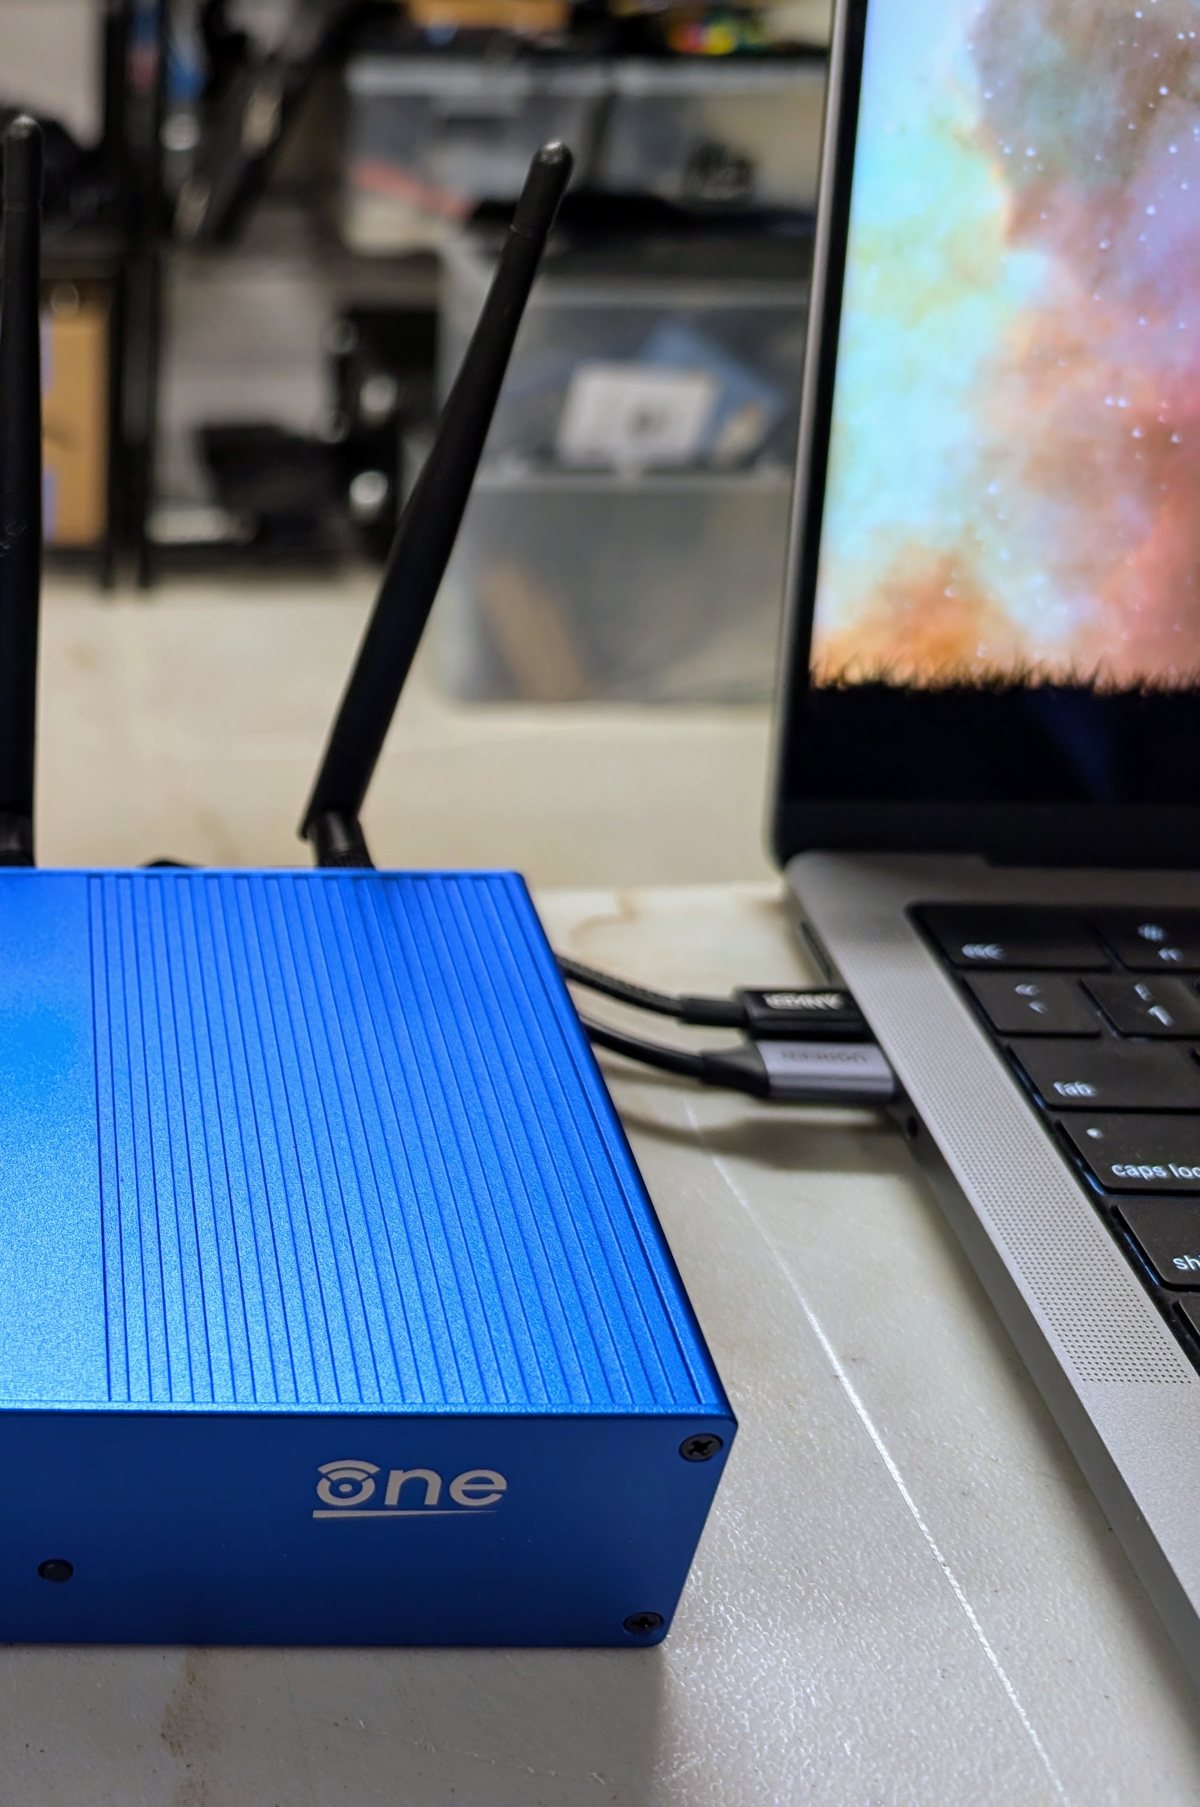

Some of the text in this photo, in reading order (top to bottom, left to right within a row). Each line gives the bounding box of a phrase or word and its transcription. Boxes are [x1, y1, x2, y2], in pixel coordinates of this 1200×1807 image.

[1053, 1082, 1097, 1097] tab
[1111, 1164, 1168, 1181] caps
[1173, 1254, 1200, 1270] sh
